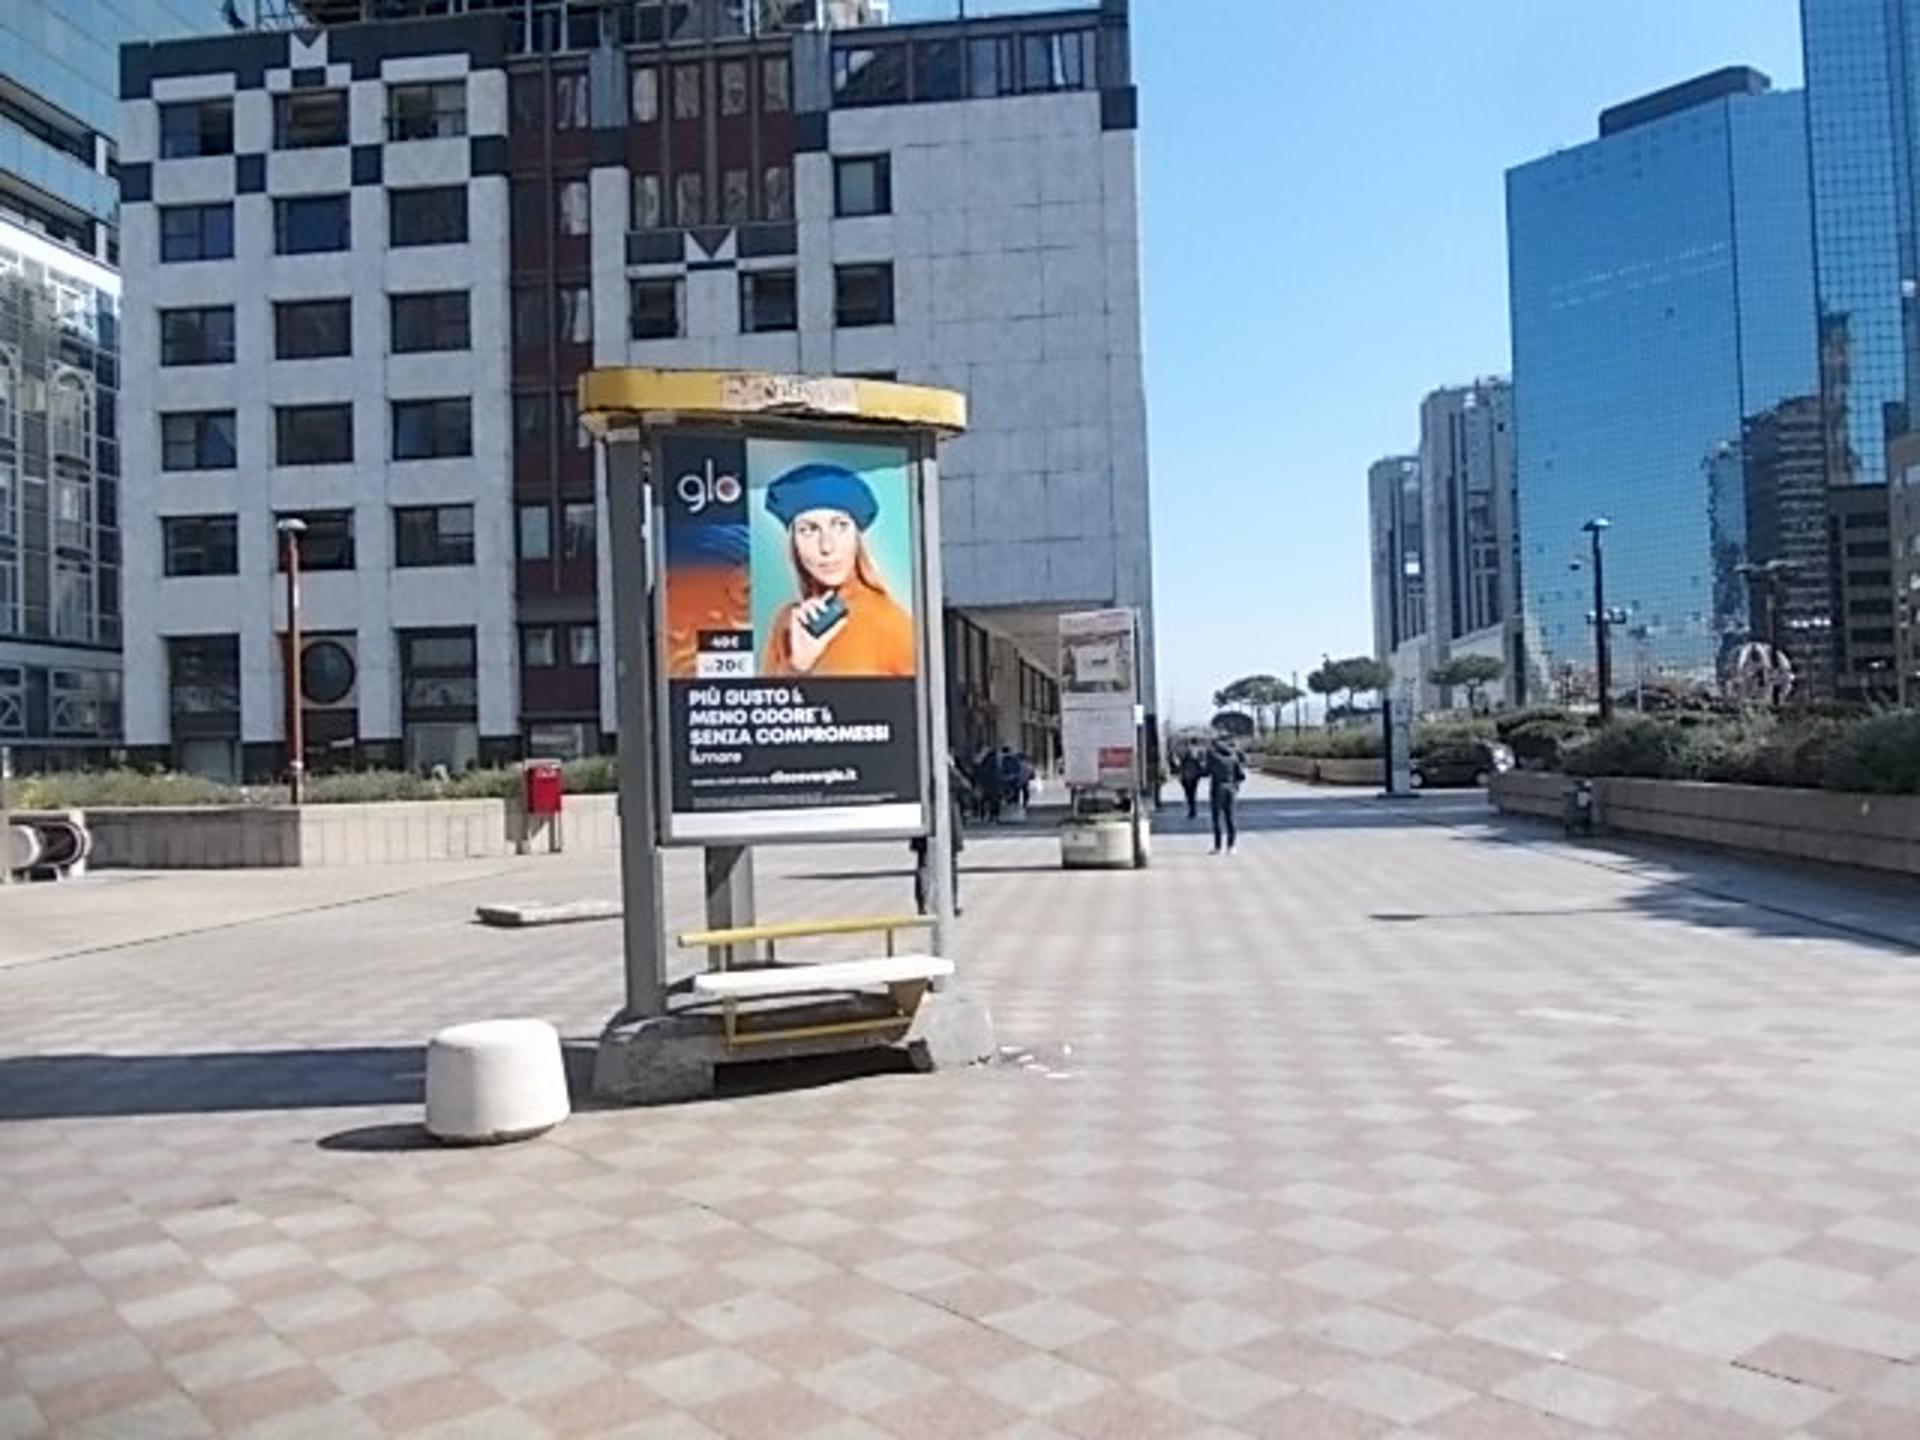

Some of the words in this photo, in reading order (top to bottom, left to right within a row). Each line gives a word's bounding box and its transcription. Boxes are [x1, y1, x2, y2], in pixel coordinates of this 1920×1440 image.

[677, 458, 742, 514] glo
[725, 688, 789, 705] GUSTO
[689, 708, 747, 726] MENO
[689, 728, 752, 746] SENZA
[755, 724, 890, 744] COMPROMESSI
